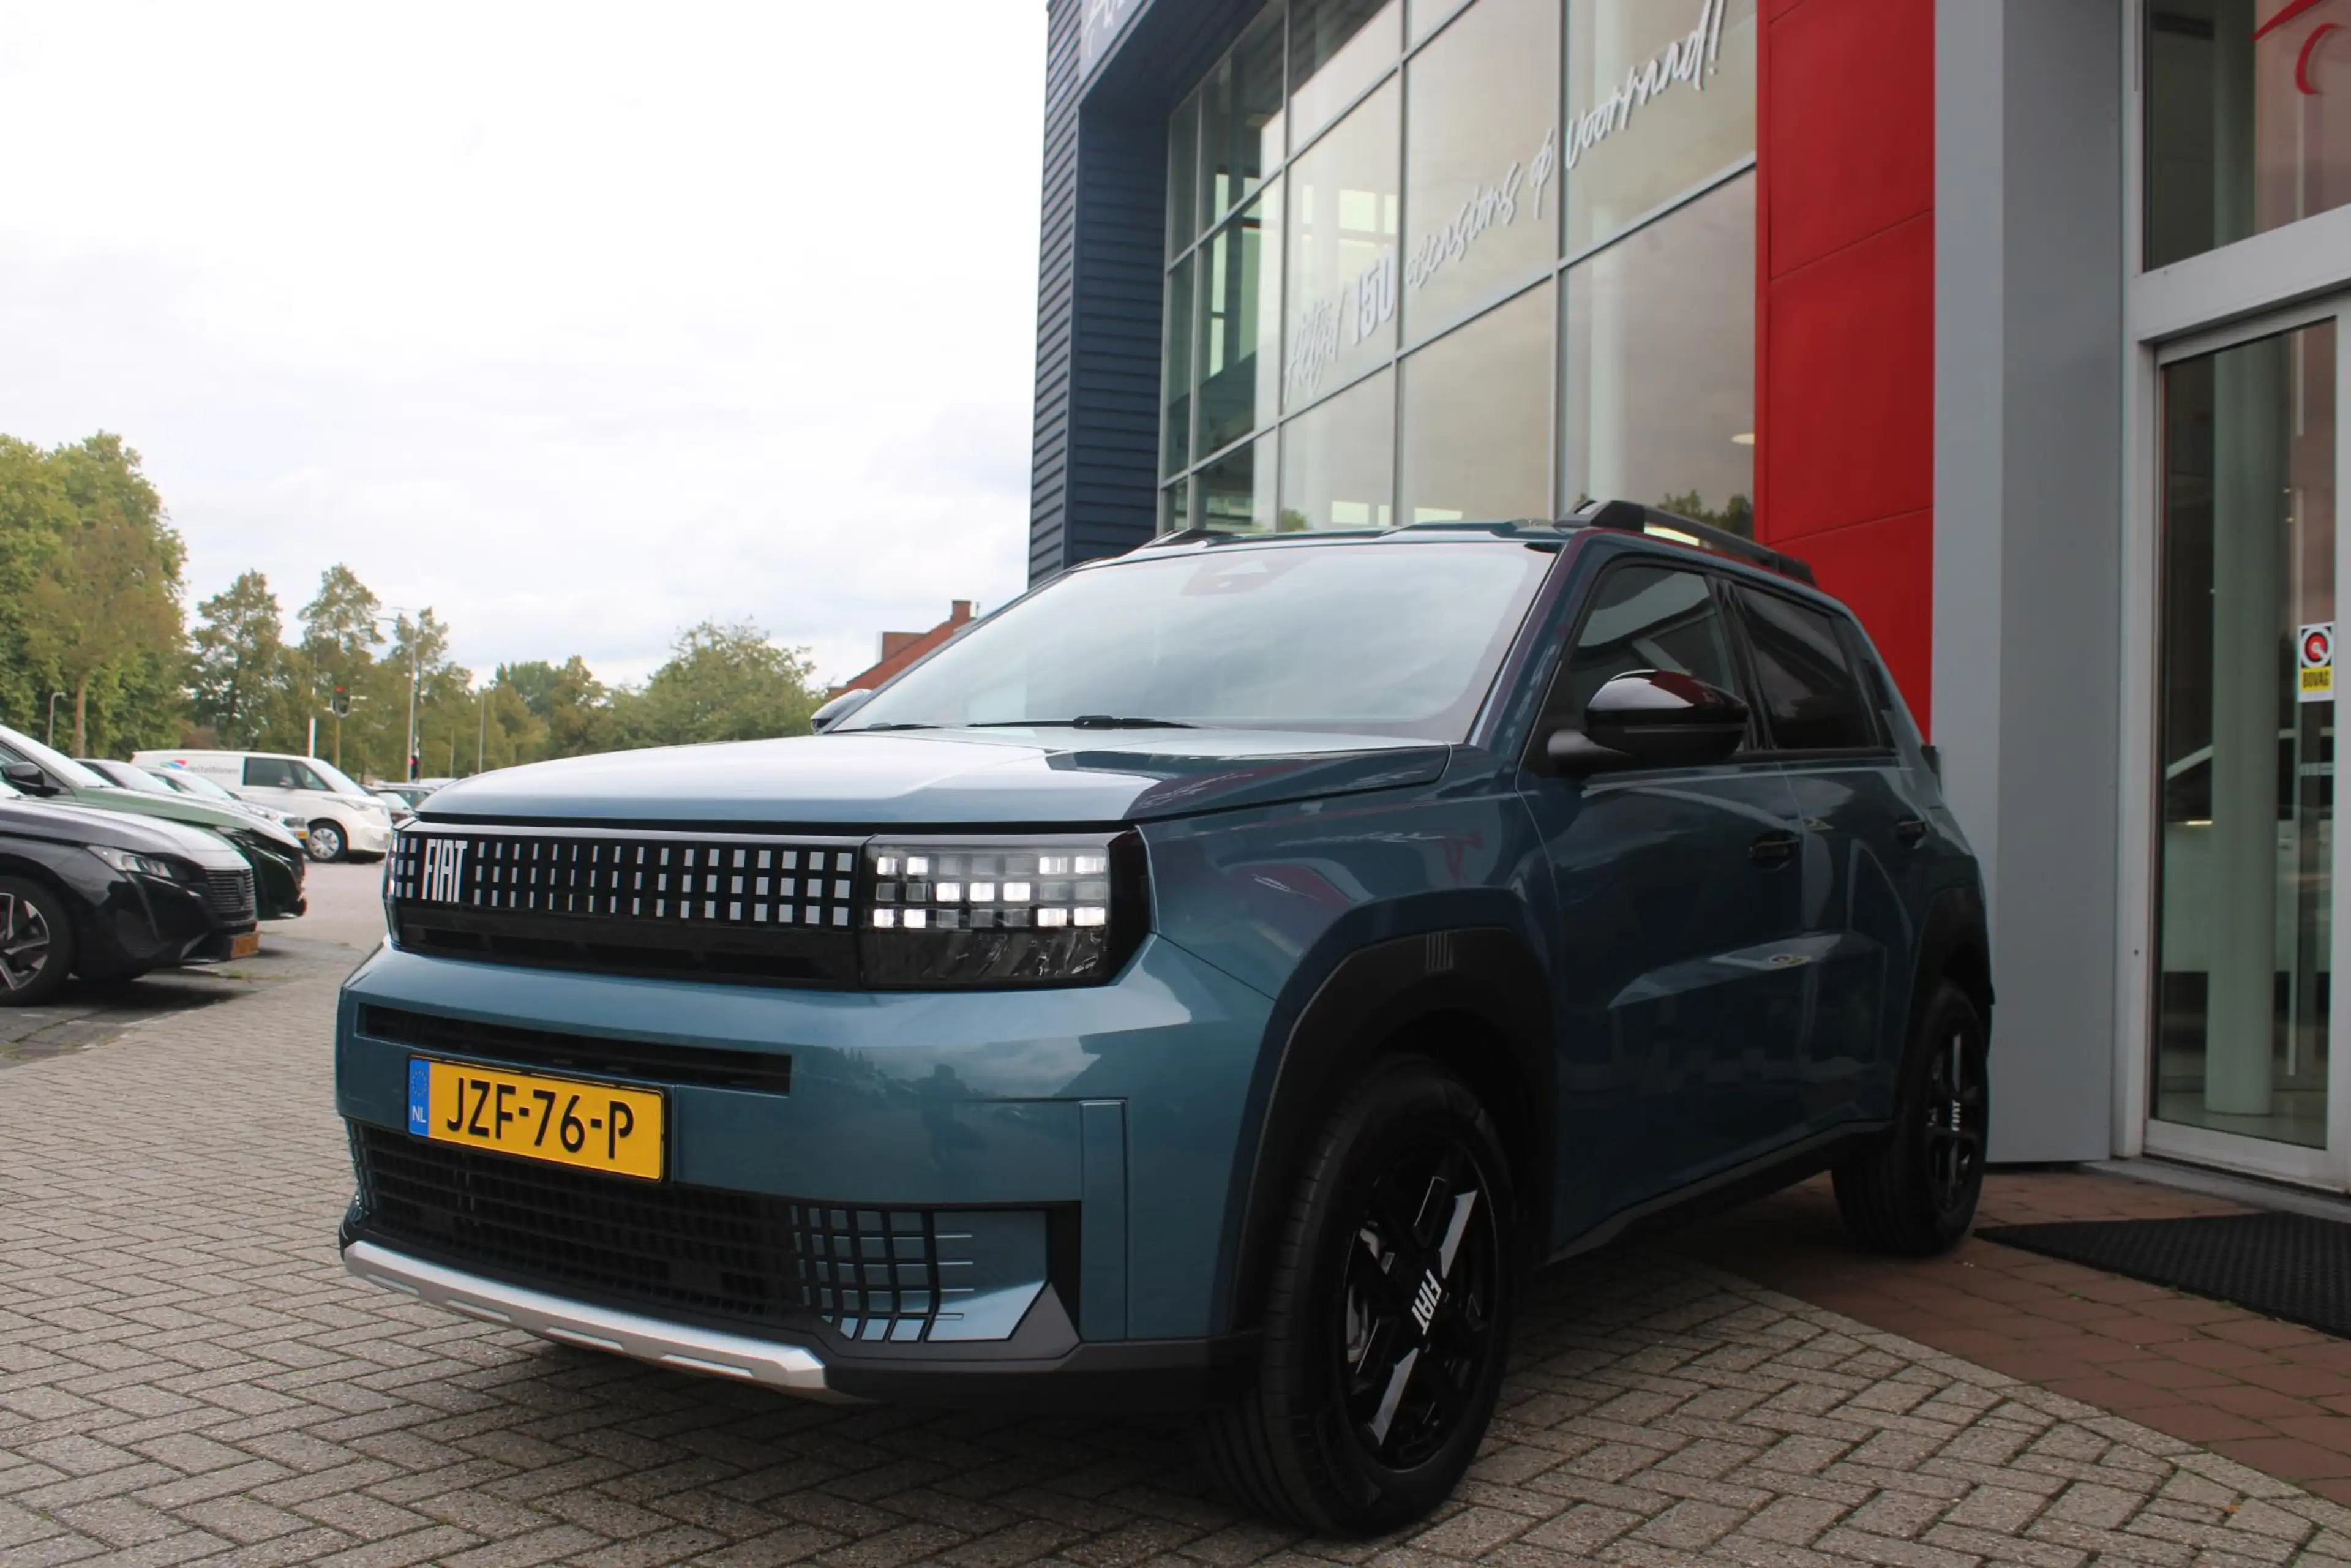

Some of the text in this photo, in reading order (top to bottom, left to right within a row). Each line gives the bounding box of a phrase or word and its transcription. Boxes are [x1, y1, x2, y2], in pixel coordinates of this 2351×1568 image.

[1351, 244, 1397, 346] 150
[1405, 160, 1524, 287] occasions
[1530, 127, 1554, 219] op
[422, 838, 468, 903] FIAT
[411, 1106, 427, 1123] NL
[447, 1077, 634, 1160] JZF-76-P
[1412, 1268, 1442, 1337] FIAT
